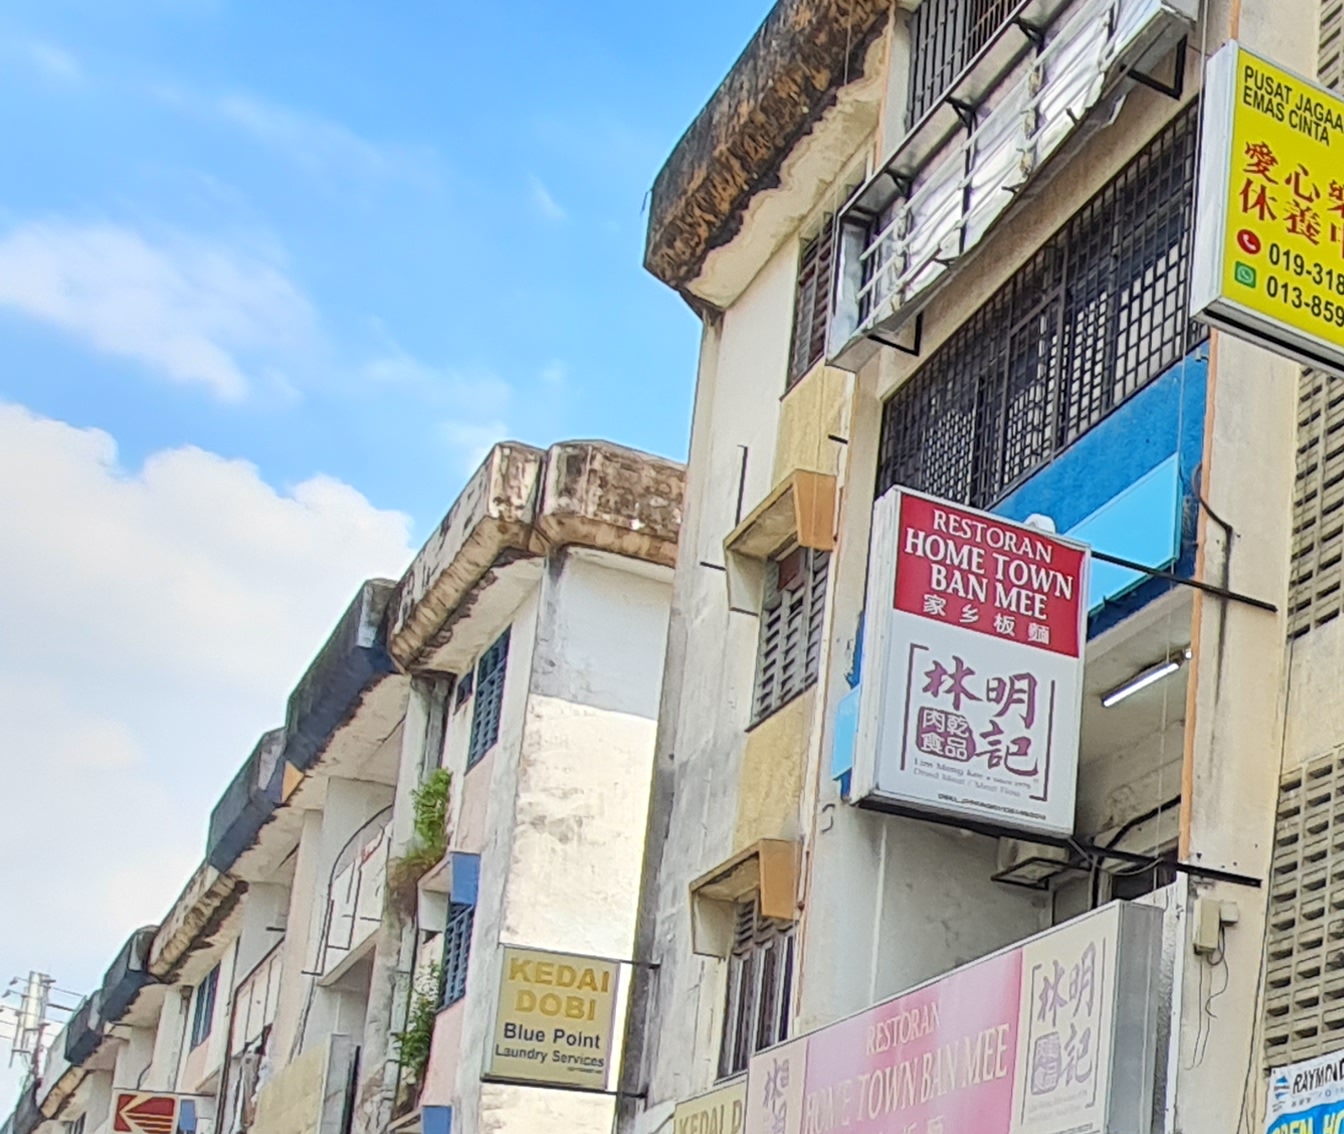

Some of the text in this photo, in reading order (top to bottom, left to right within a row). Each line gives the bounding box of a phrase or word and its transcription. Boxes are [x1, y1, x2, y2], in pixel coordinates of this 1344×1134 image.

[1244, 65, 1292, 106] PUSAT
[1243, 86, 1330, 147] EMAS CINTA
[904, 528, 1074, 600] HOME TOWN
[933, 509, 1053, 564] RESTORAN
[930, 563, 1048, 620] BAN MEE
[922, 655, 1038, 730] 林明
[976, 719, 1039, 778] 記
[508, 957, 610, 993] KEDAI
[515, 989, 598, 1021] DOBI
[866, 1000, 941, 1056] RESTORAN
[494, 1044, 605, 1067] Laundry Services
[503, 1021, 601, 1049] Blue Point
[854, 1058, 921, 1124] TOWN
[919, 1038, 960, 1104] BAN
[961, 1022, 1011, 1089] MEE
